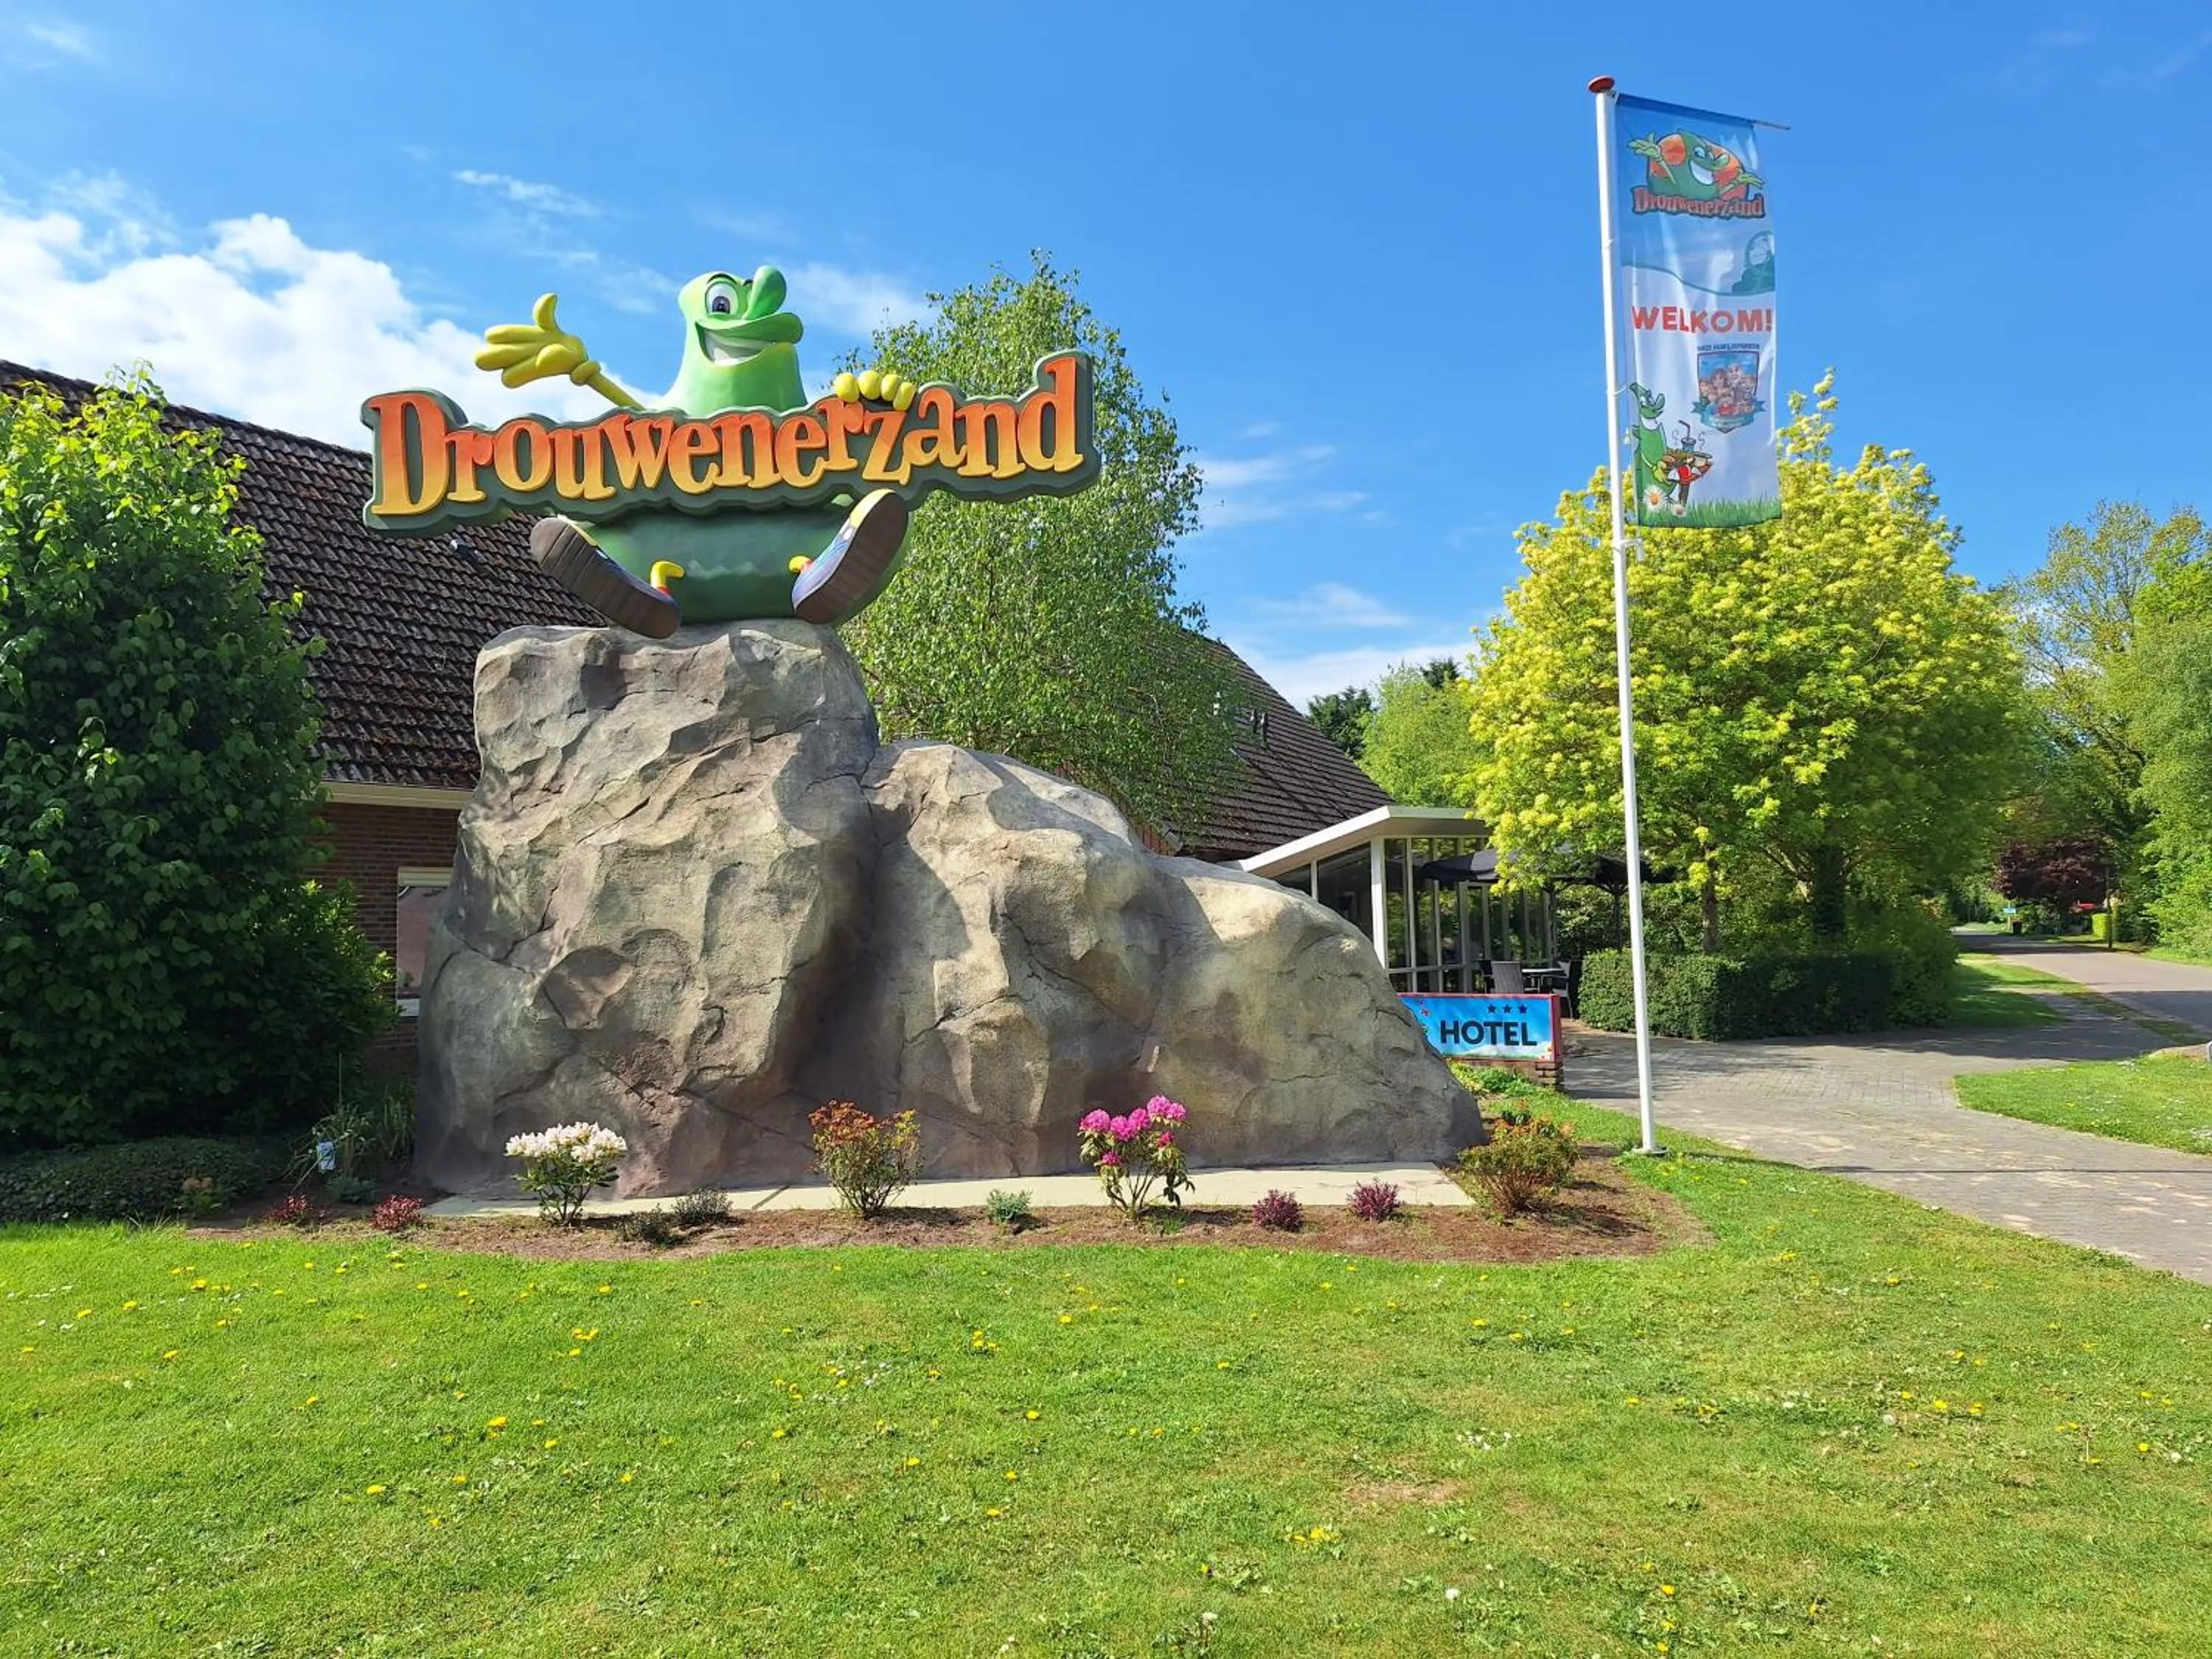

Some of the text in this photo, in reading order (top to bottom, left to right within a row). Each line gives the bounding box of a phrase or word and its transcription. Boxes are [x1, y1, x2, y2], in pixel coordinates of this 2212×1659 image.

[1634, 187, 1762, 216] Drouwenerzand
[1632, 307, 1773, 333] WELKOM!
[368, 356, 1085, 517] Drouwenerzand
[1440, 1020, 1537, 1046] HOTEL
